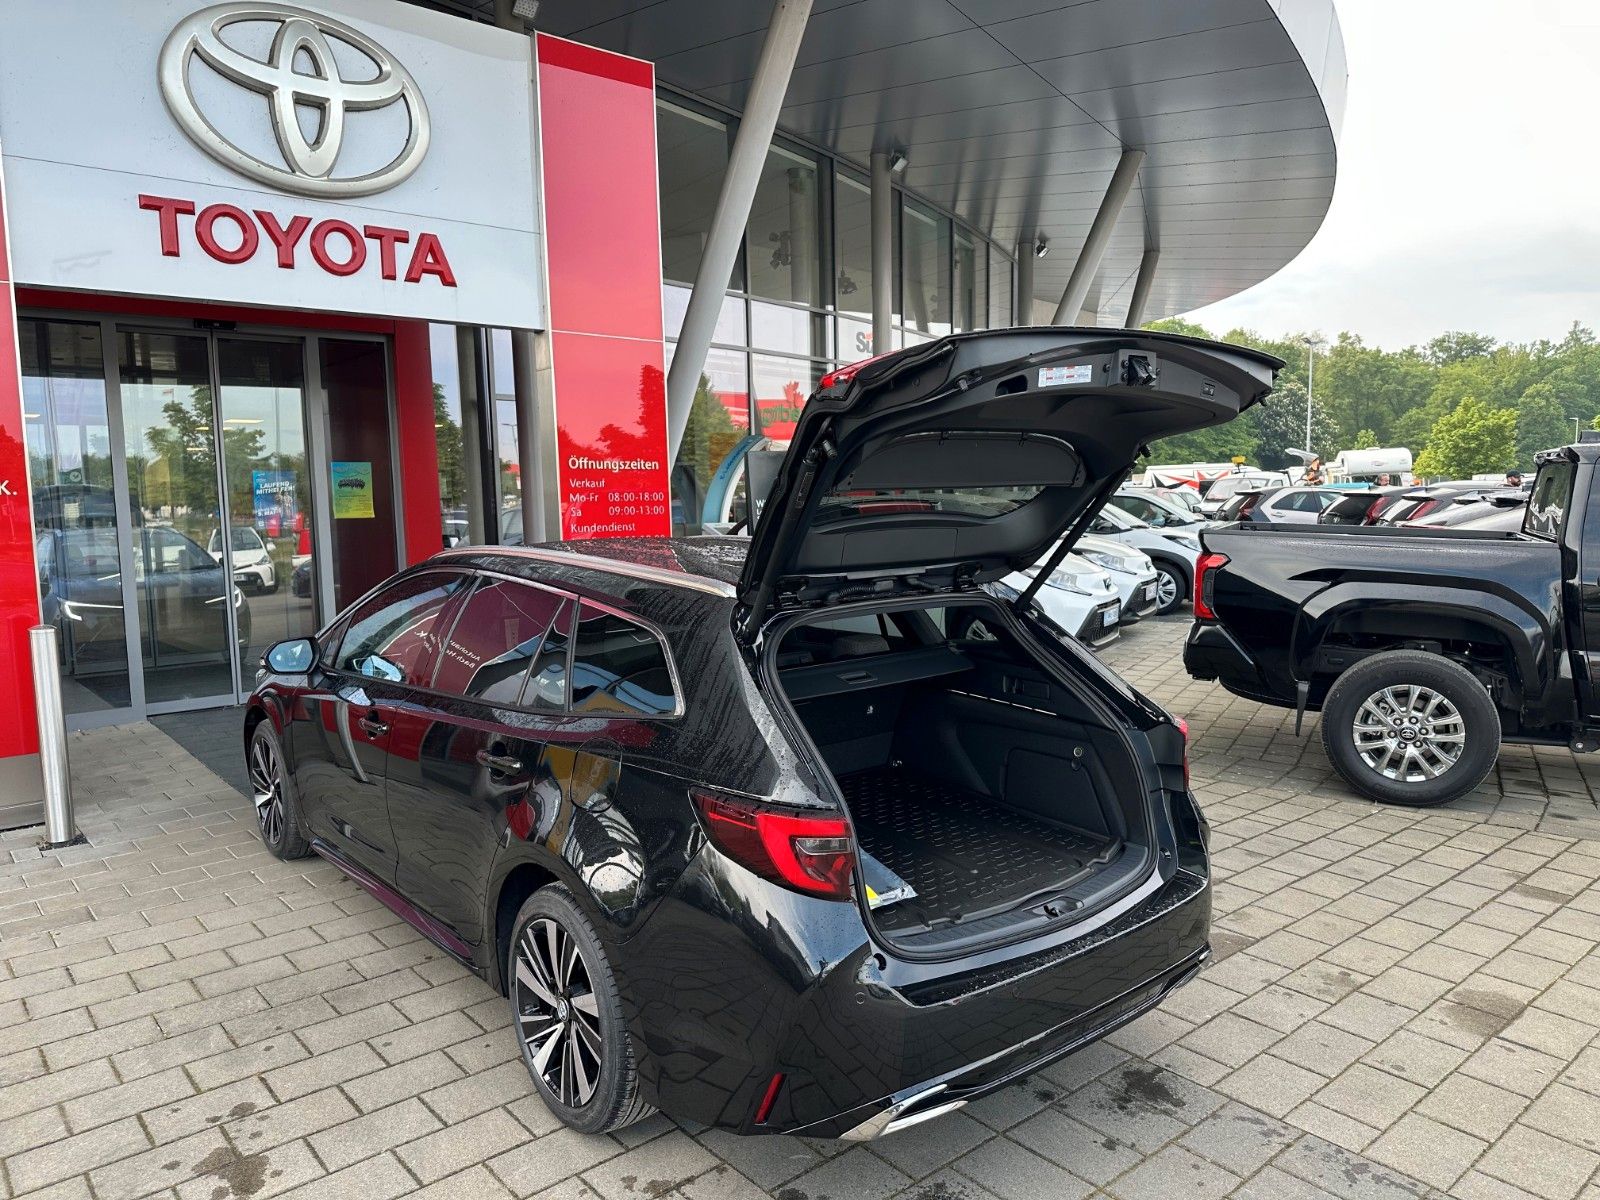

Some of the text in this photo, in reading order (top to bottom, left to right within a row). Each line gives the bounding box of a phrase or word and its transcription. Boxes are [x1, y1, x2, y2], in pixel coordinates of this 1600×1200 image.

[138, 193, 457, 288] TOYOTA
[568, 455, 660, 473] Öffnungszeiten
[569, 478, 605, 488] Verkauf
[569, 492, 665, 503] Mo-Fr 08:00-18:00
[570, 506, 665, 517] Sa 09:00-13:00
[570, 522, 636, 533] Kundendienst
